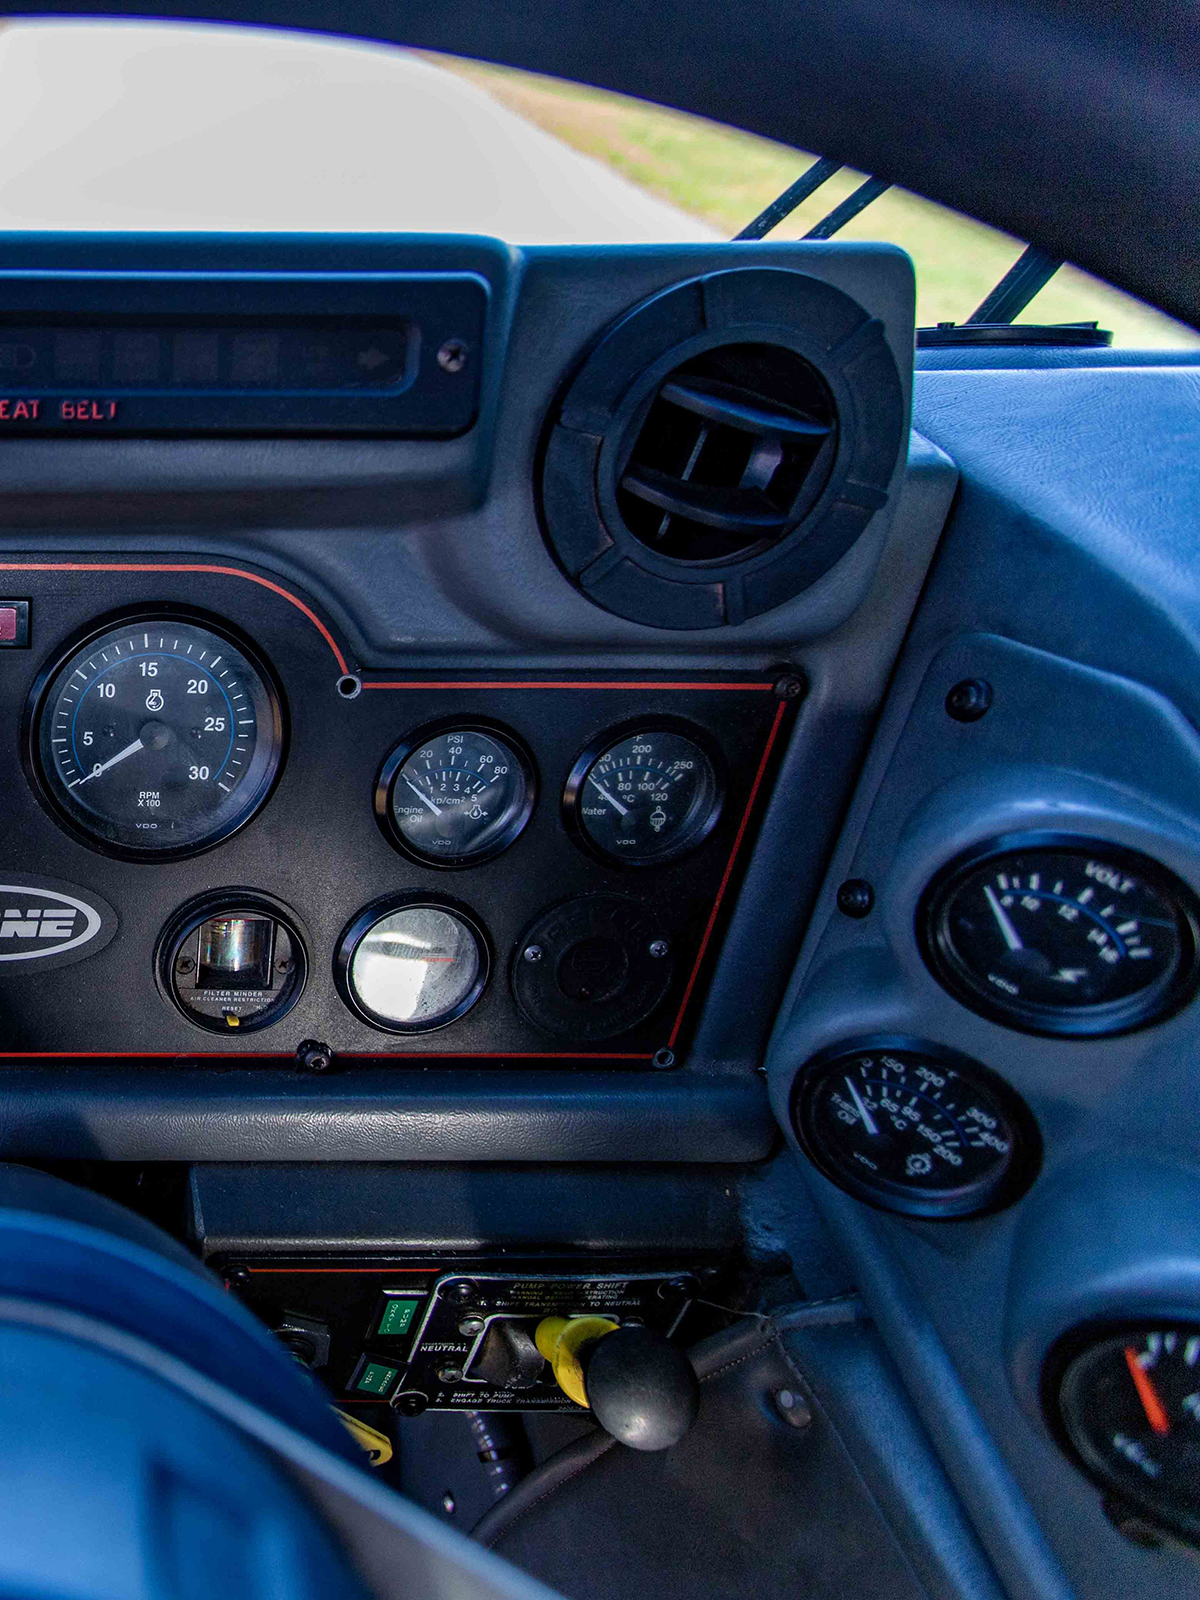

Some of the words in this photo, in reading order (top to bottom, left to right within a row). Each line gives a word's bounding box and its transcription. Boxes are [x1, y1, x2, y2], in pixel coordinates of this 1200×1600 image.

[61, 401, 117, 419] BELT
[139, 663, 158, 677] 15
[98, 684, 115, 697] 10
[187, 680, 208, 694] 20
[204, 718, 225, 731] 25
[83, 732, 93, 746] 5
[632, 745, 652, 753] 200
[480, 755, 493, 763] 60
[189, 766, 209, 780] 30
[394, 806, 423, 814] Engine
